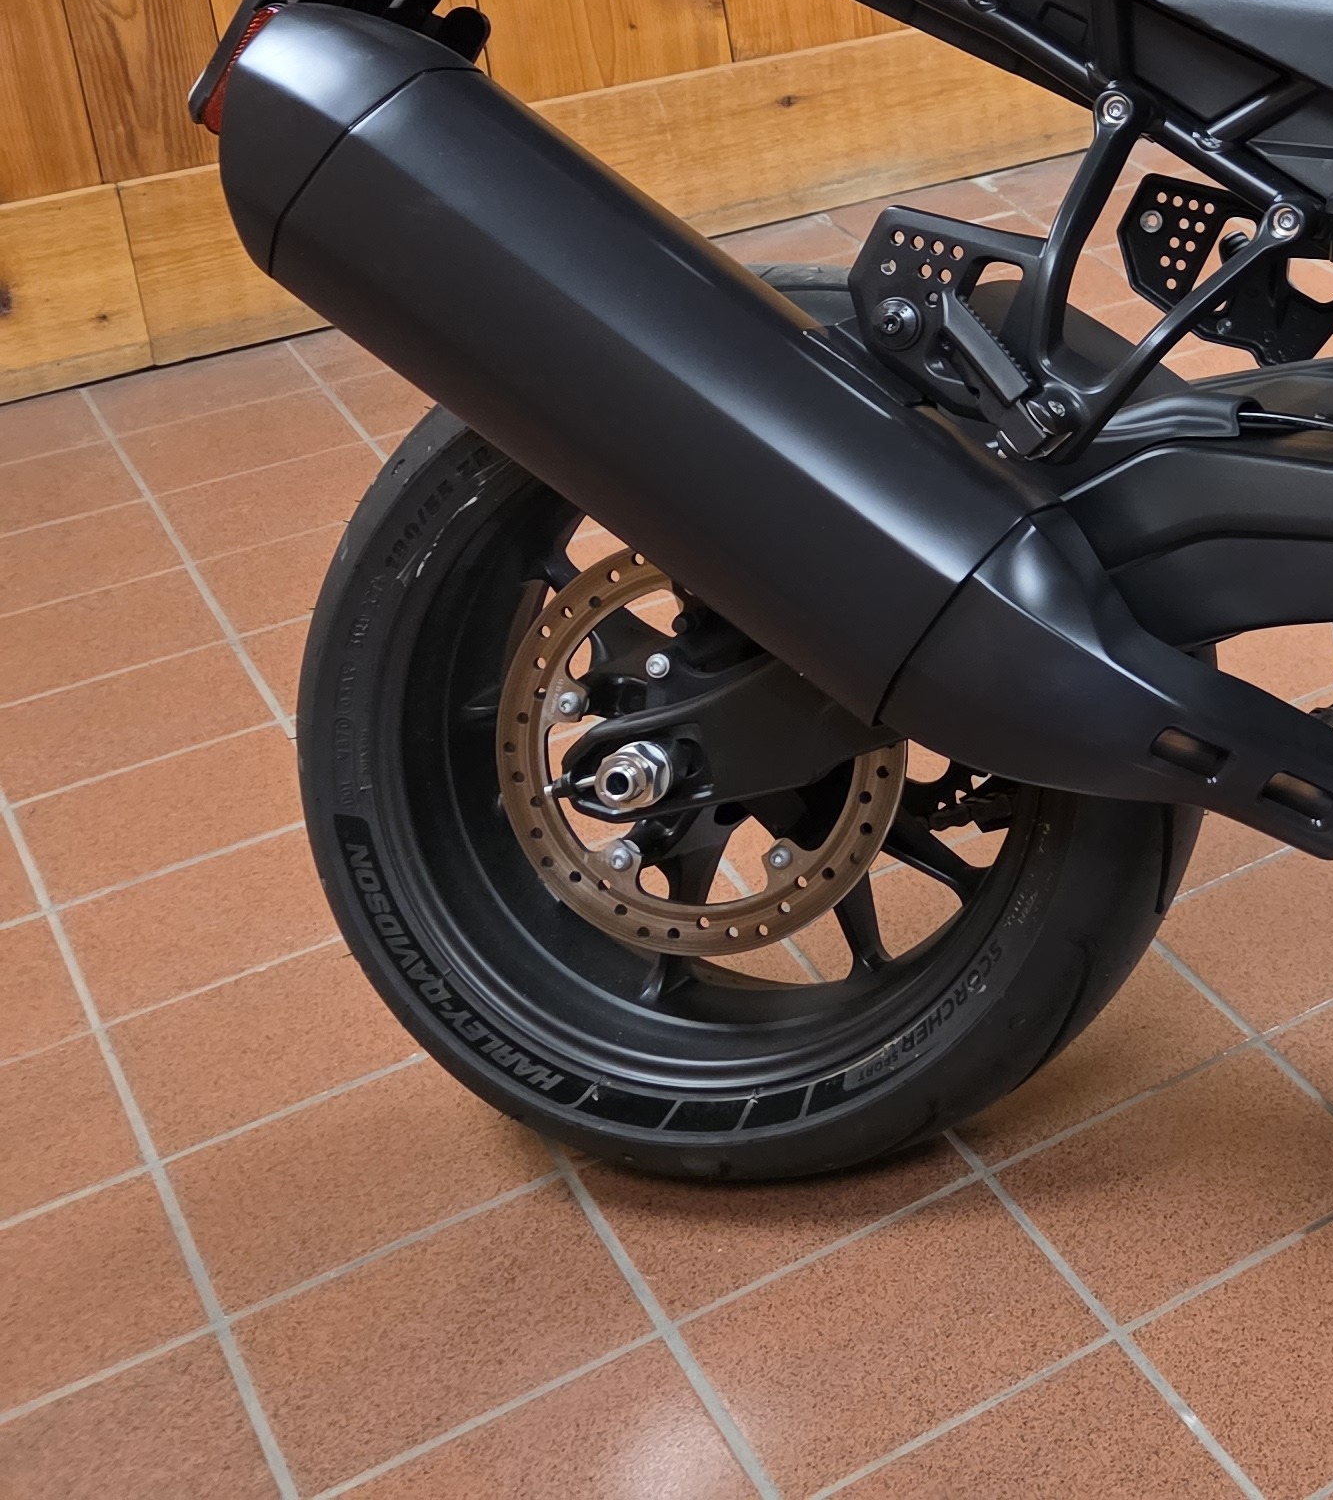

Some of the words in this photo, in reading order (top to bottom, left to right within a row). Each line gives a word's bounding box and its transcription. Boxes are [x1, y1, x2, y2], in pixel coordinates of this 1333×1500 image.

[345, 843, 566, 1092] HARLEY-DAVIDSON
[899, 939, 1003, 1054] SCORCHER
[857, 1049, 899, 1083] SPORT
